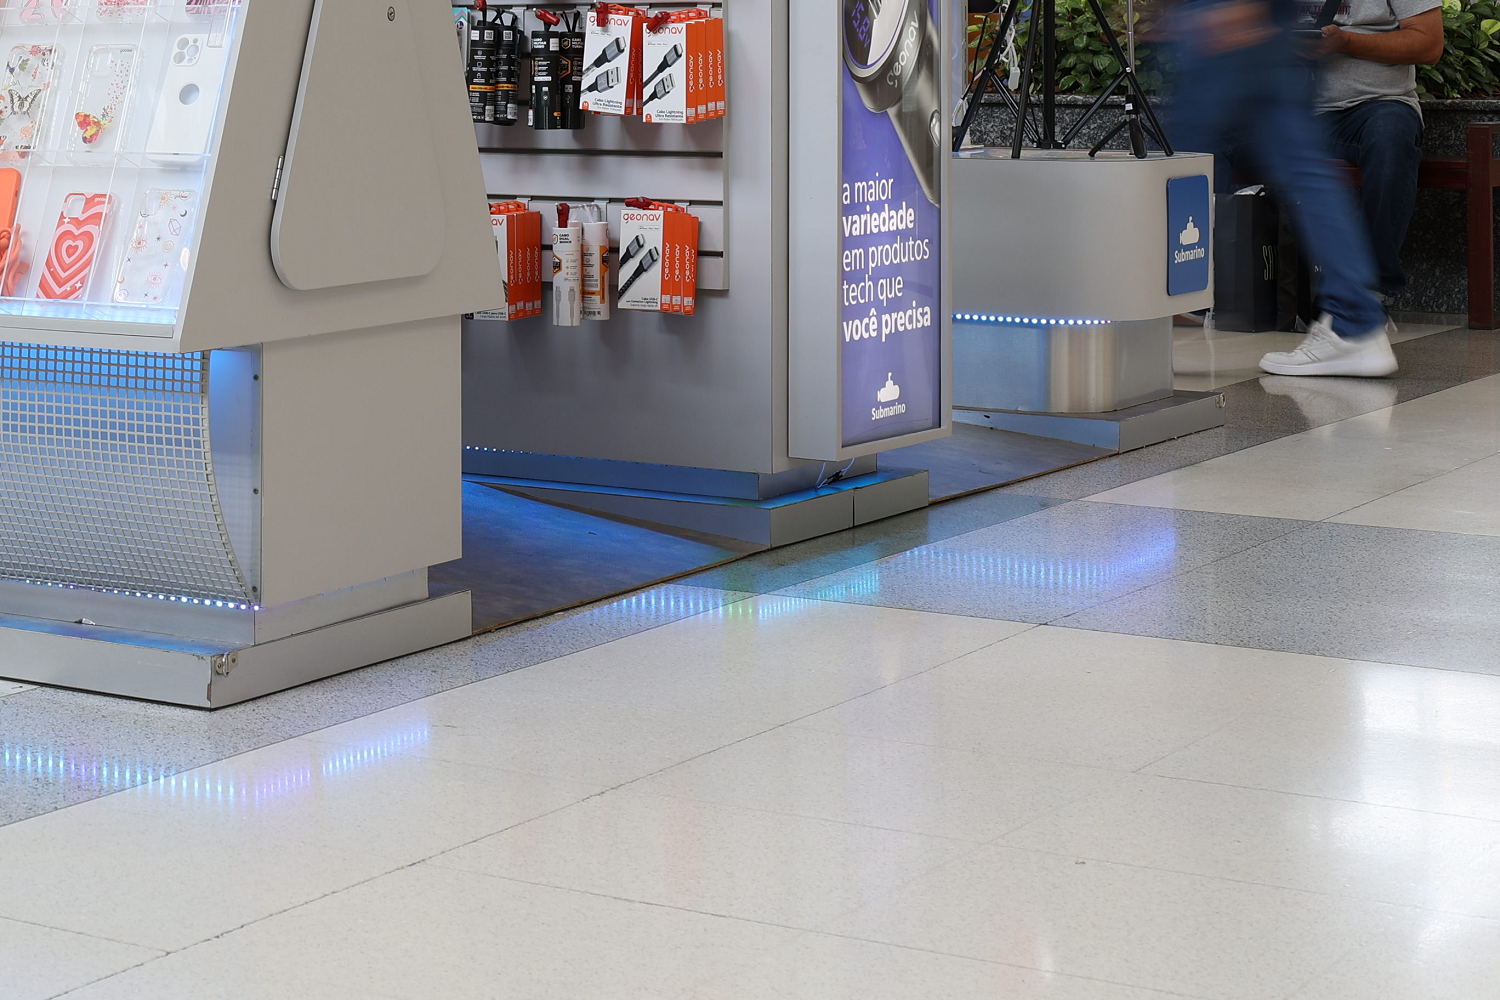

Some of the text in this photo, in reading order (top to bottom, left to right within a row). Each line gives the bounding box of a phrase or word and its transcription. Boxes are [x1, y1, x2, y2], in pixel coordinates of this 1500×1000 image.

[886, 9, 921, 89] geonav
[842, 172, 894, 205] a maior
[622, 213, 661, 223] geonav
[842, 201, 915, 238] variedade
[842, 236, 930, 276] em produtos
[1174, 245, 1205, 264] Submarino
[842, 274, 904, 307] tech que
[842, 300, 931, 342] você precisa
[871, 402, 906, 421] Submarino
